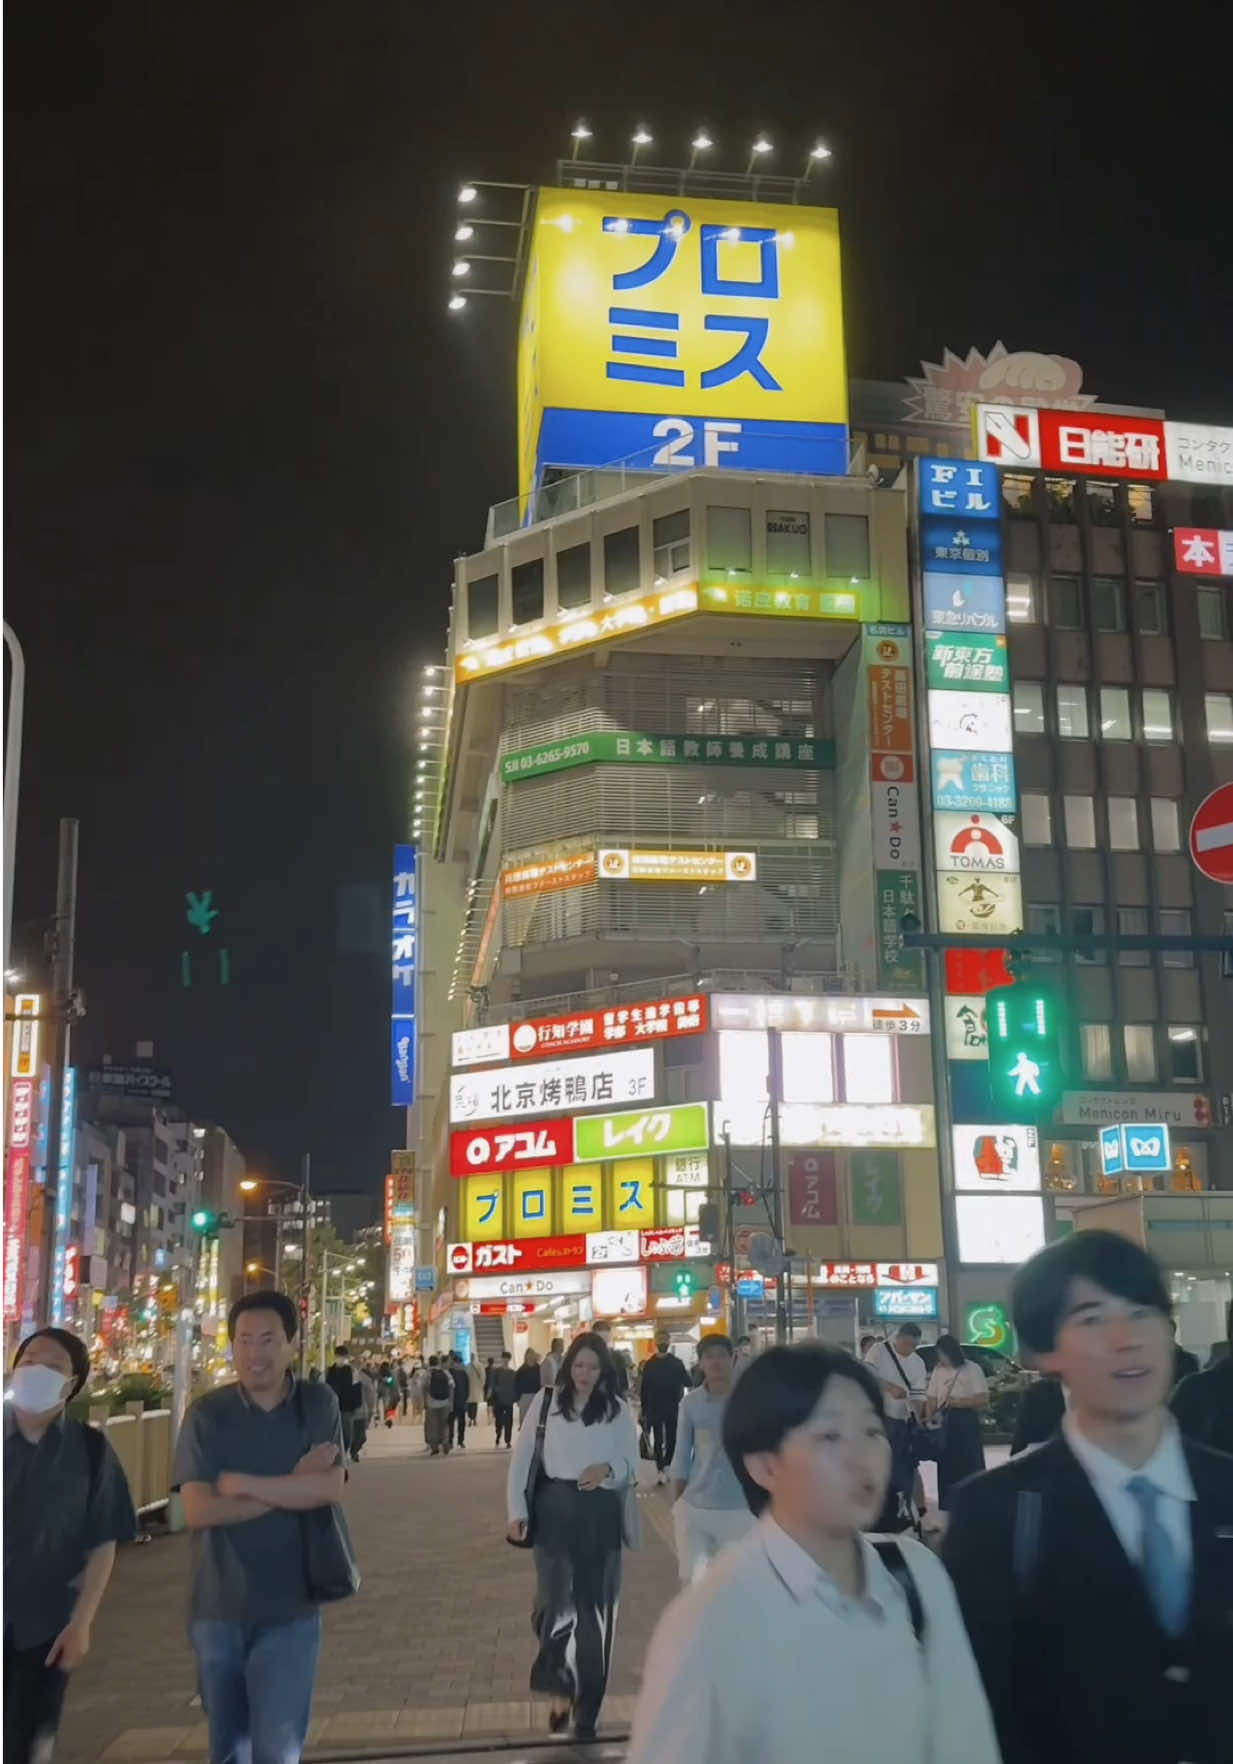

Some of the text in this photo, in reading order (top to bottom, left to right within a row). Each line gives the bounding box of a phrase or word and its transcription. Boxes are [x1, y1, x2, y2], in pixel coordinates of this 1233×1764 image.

[602, 209, 780, 299] プロ
[606, 306, 784, 391] ミス
[652, 418, 742, 467] 2F
[1059, 425, 1160, 470] 日能研
[930, 465, 983, 486] FI
[931, 489, 991, 510] ビル
[1181, 534, 1216, 568] 本
[950, 855, 1006, 869] TOMAS
[536, 1018, 594, 1042] 行知学園
[490, 1072, 614, 1113] 北京烤鴨店
[628, 1076, 647, 1097] 3F
[1079, 1106, 1182, 1121] Menicon Miru
[493, 1130, 558, 1162] アコム
[603, 1112, 672, 1149] レイク
[475, 1180, 644, 1224] プロミス
[475, 1243, 522, 1268] ガスト
[500, 1278, 554, 1295] Can Do
